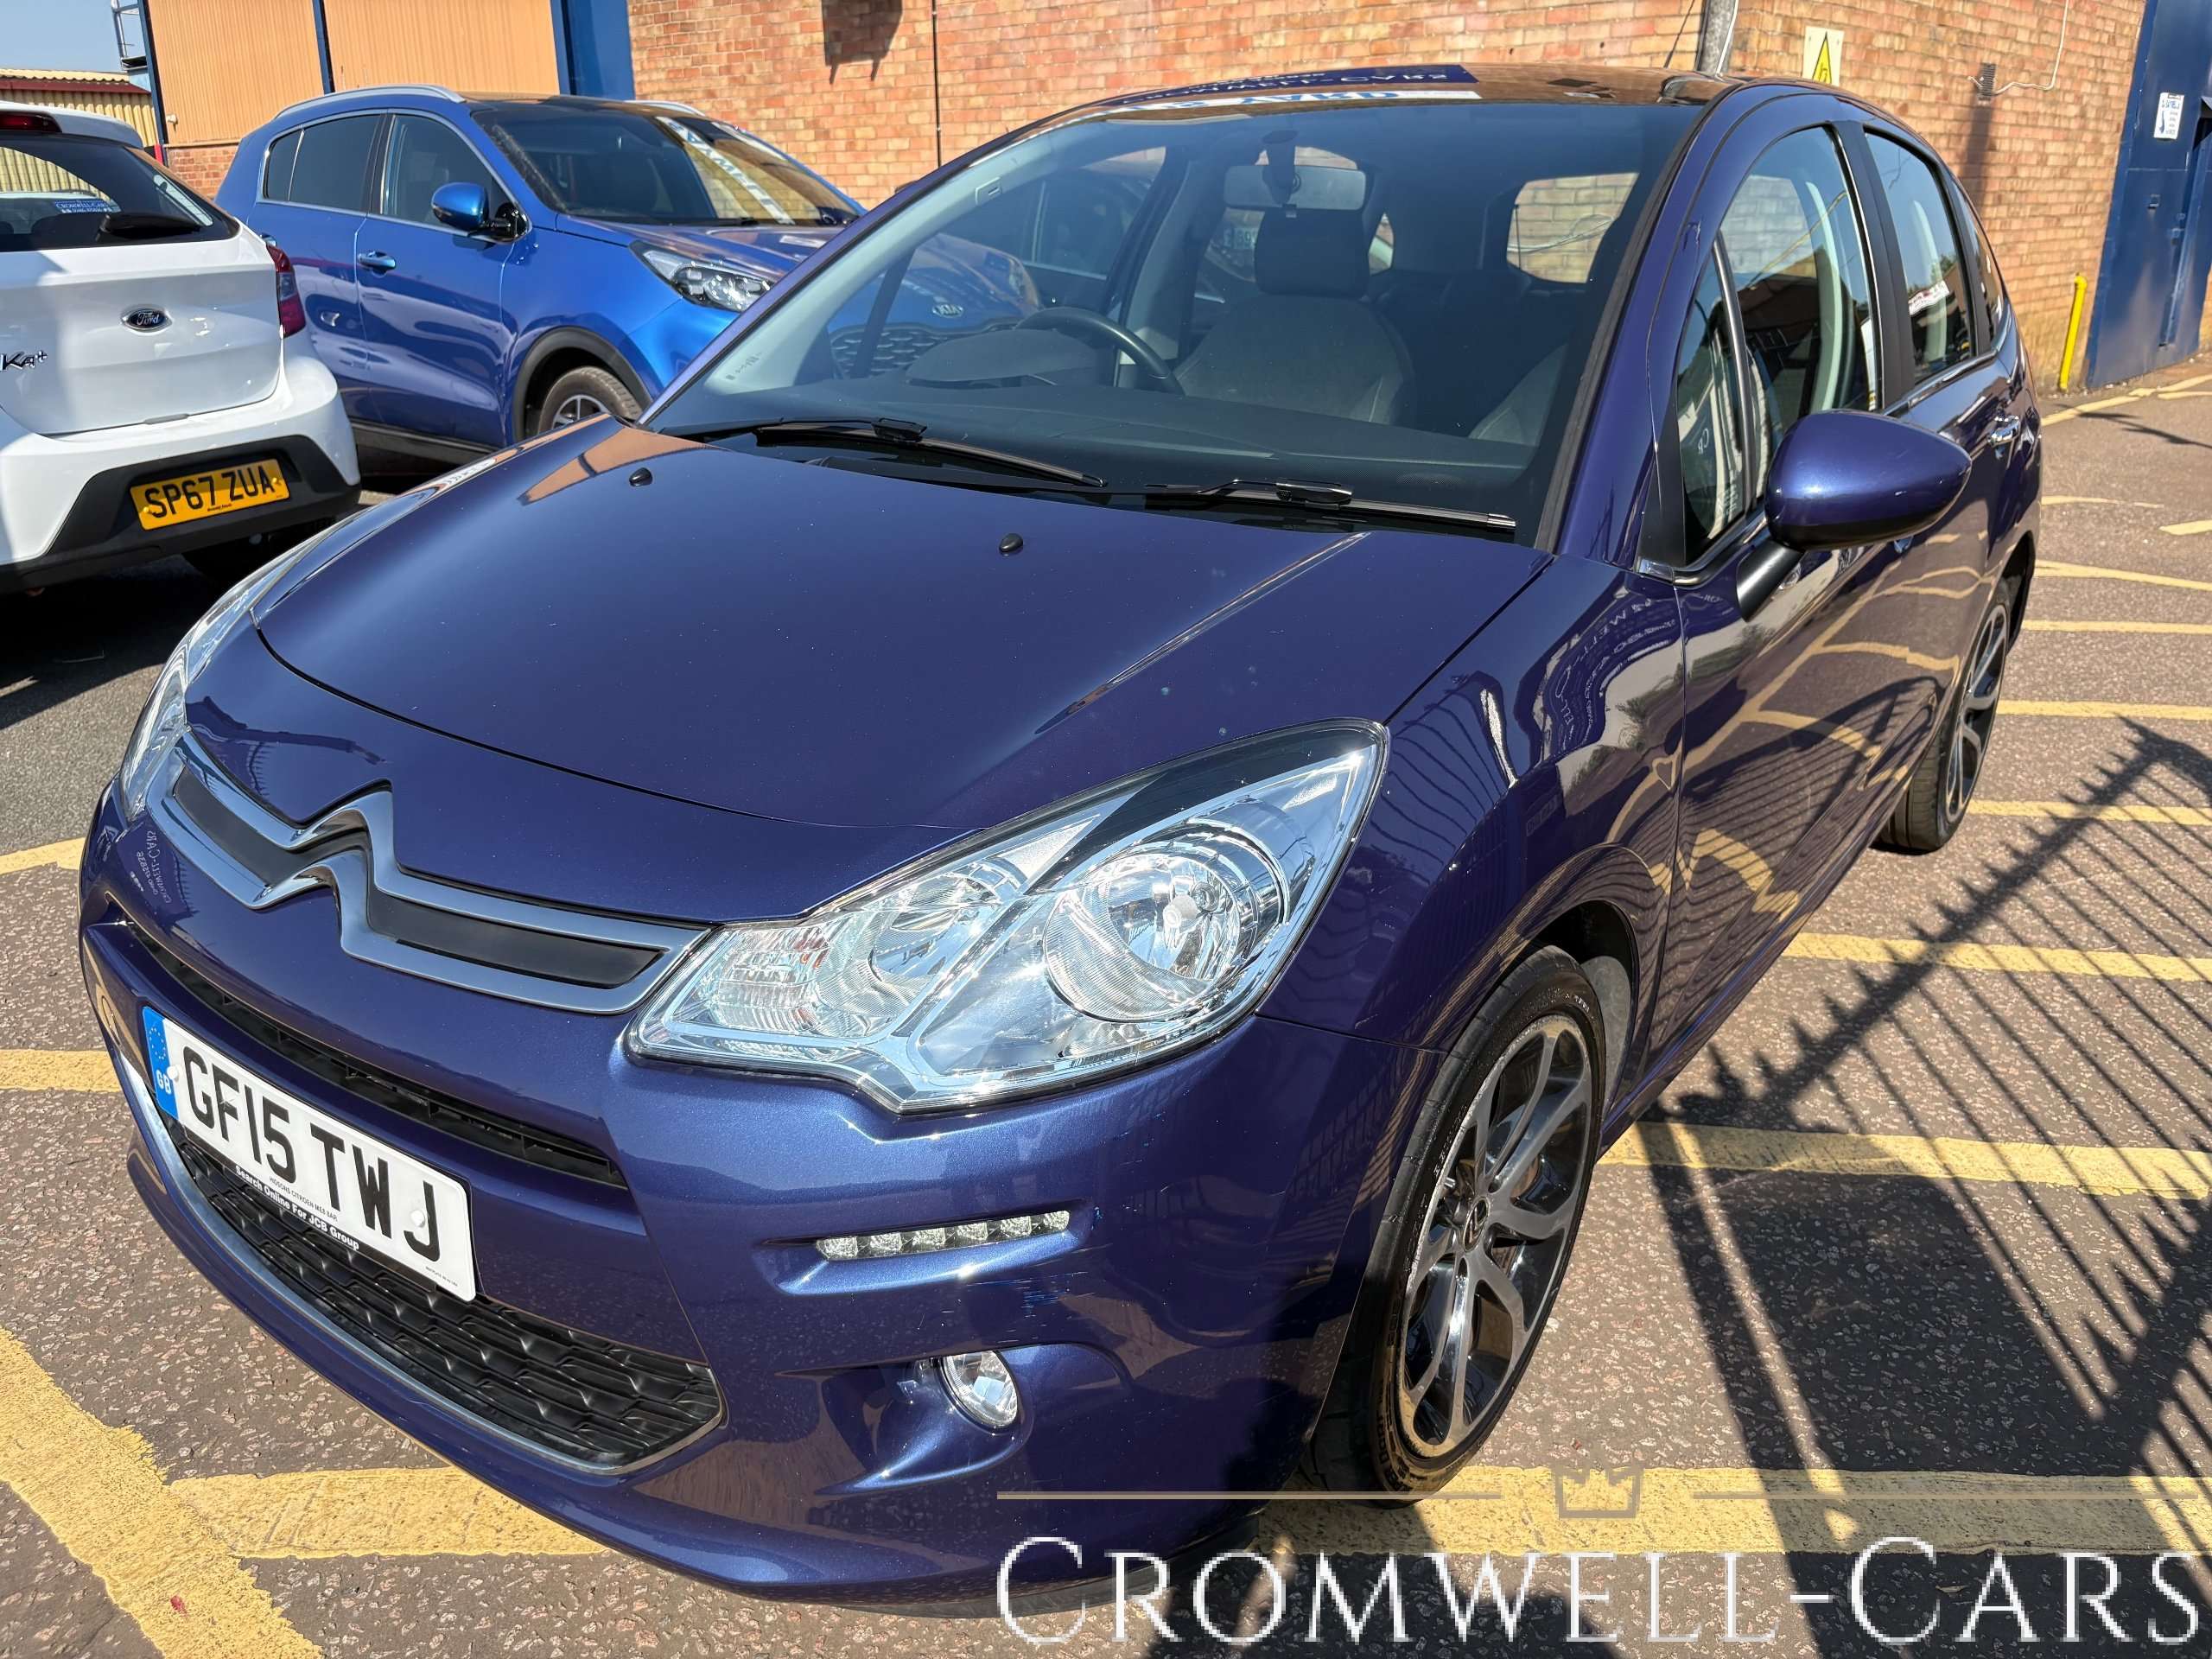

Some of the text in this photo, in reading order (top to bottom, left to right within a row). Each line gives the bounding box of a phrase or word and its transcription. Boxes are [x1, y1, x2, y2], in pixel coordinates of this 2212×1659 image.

[136, 310, 161, 326] Ford
[938, 304, 962, 315] KIA
[144, 465, 276, 518] SP67 ZUA
[156, 1069, 172, 1096] GB
[182, 1046, 441, 1262] GF15 TWJ
[235, 1165, 359, 1251] Search Online For JCB Group
